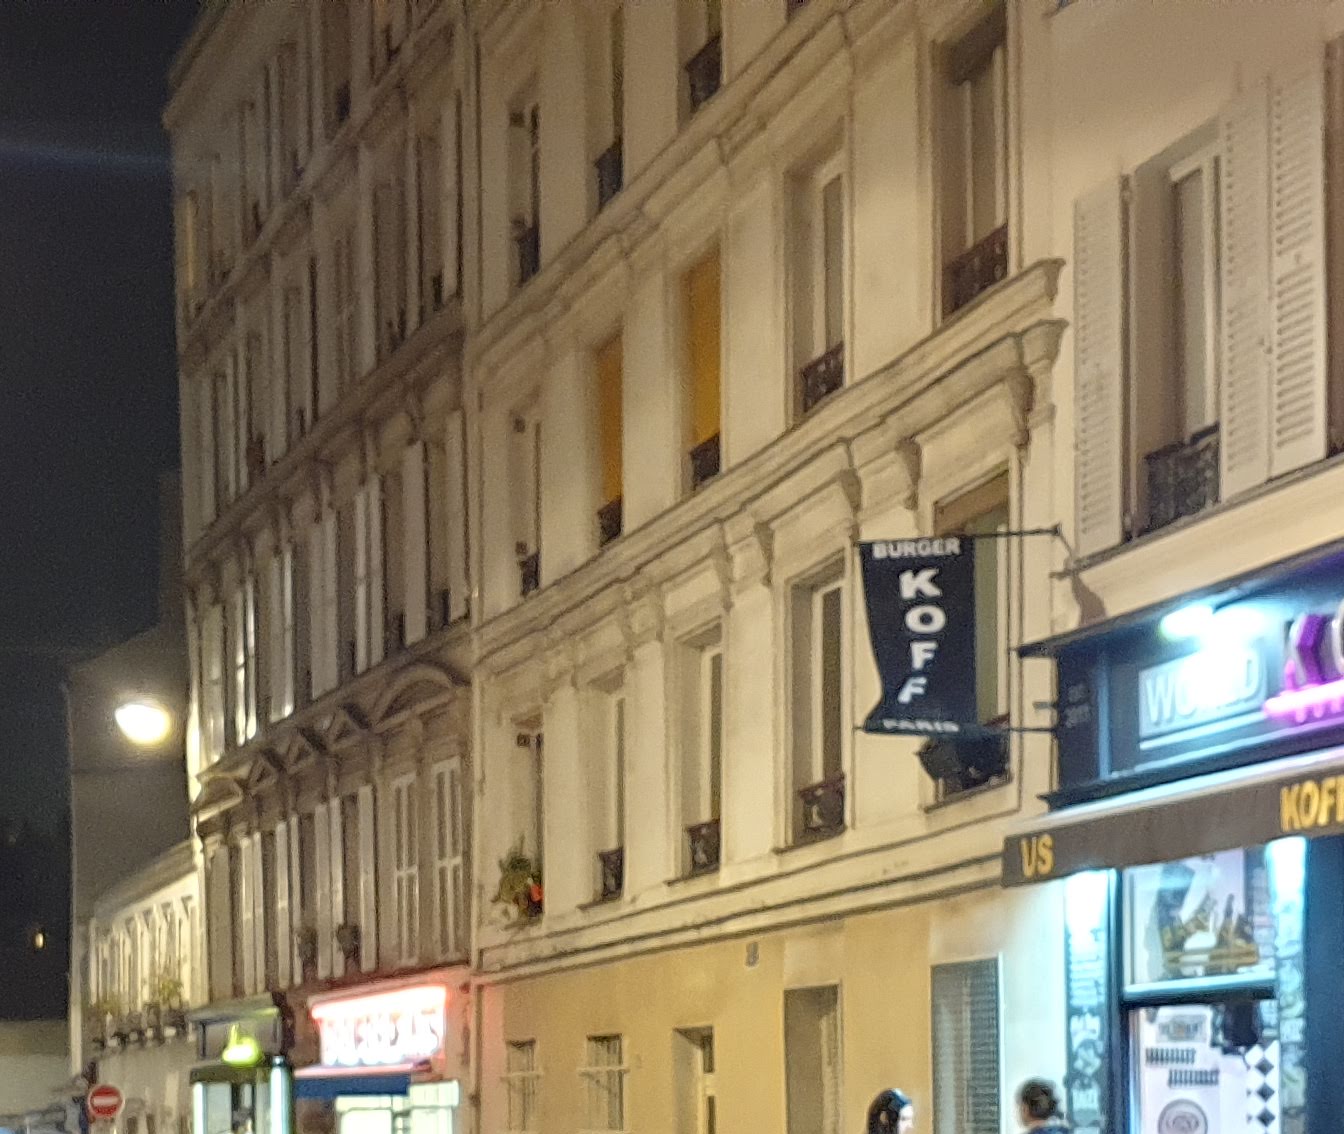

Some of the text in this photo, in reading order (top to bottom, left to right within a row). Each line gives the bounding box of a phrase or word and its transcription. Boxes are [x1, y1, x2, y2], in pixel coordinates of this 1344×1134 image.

[872, 537, 960, 559] BURGER
[897, 567, 947, 704] KOFF
[1144, 648, 1260, 725] WOD
